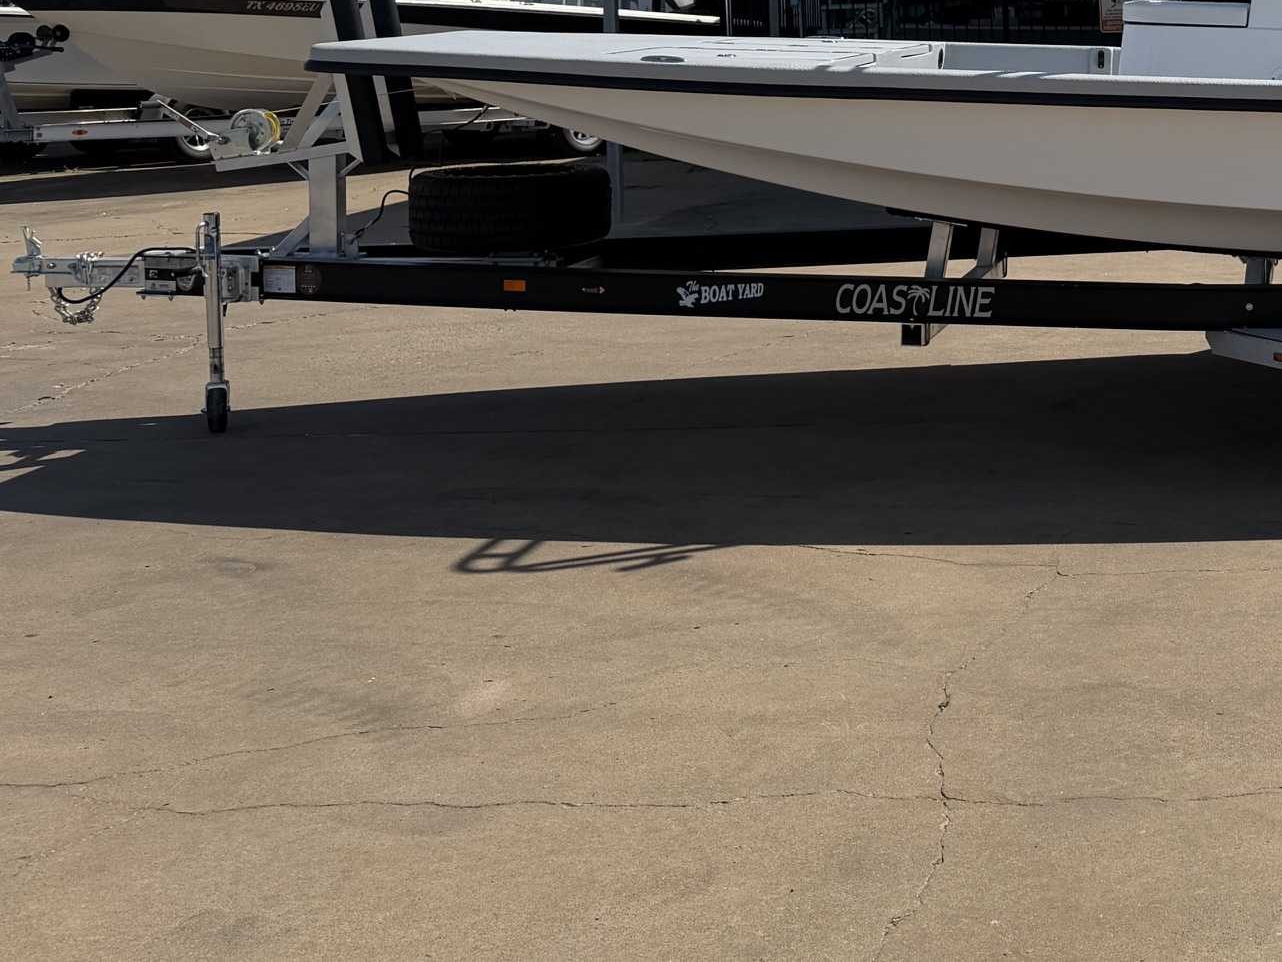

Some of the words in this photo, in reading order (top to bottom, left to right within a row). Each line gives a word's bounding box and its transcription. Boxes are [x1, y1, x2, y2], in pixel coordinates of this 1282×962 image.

[246, 0, 265, 10] TX
[700, 284, 735, 304] BOAT
[738, 283, 764, 299] YARD
